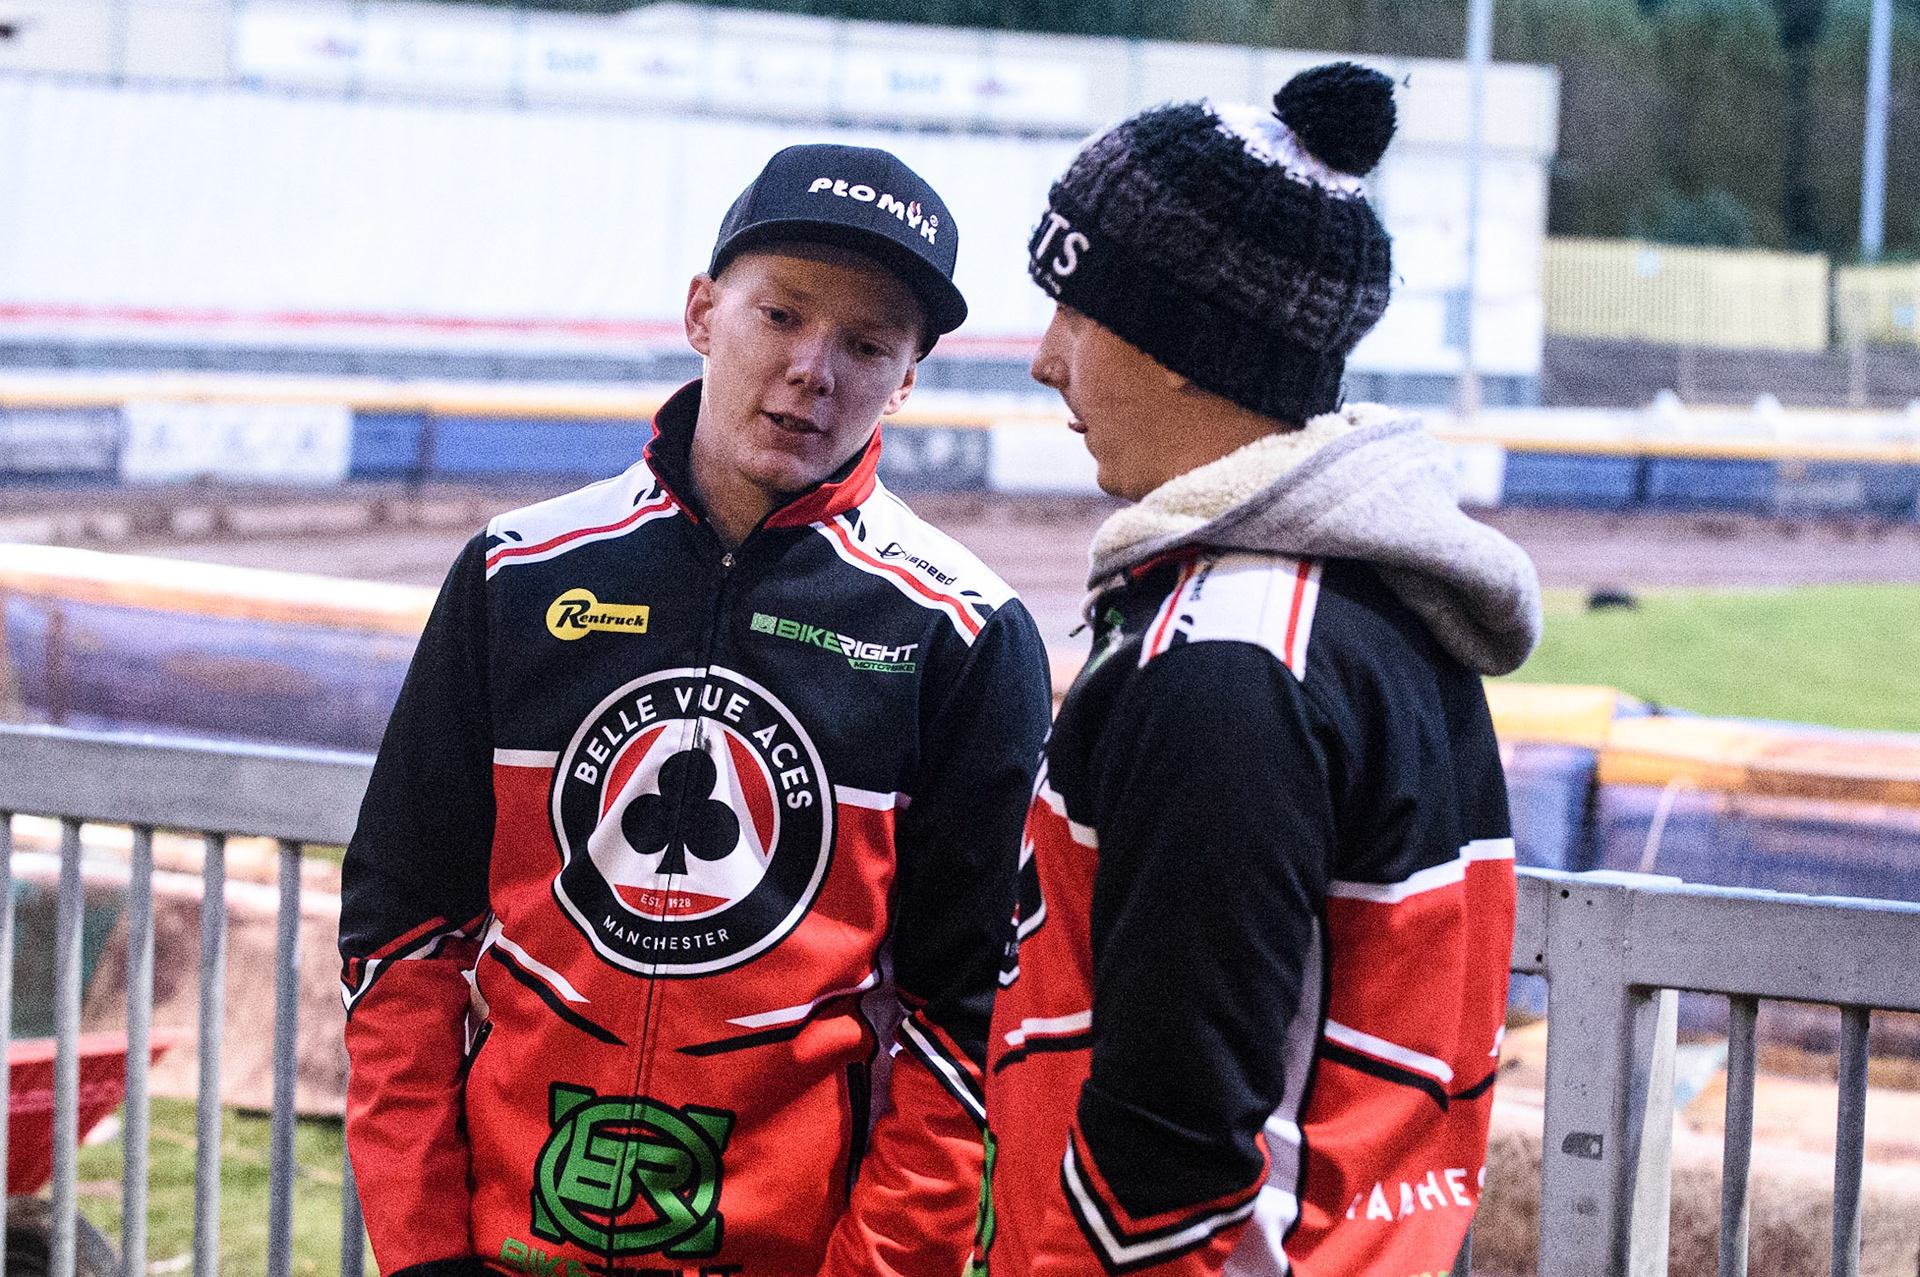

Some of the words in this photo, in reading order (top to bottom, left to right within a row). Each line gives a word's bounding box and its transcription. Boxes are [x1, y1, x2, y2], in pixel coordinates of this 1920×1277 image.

[555, 599, 645, 629] Rentruck
[775, 618, 919, 662] BIKERIGHT
[574, 694, 657, 786] BELLE
[674, 684, 750, 723] VUE
[753, 723, 813, 810] ACES
[603, 915, 729, 950] MANCHESTER
